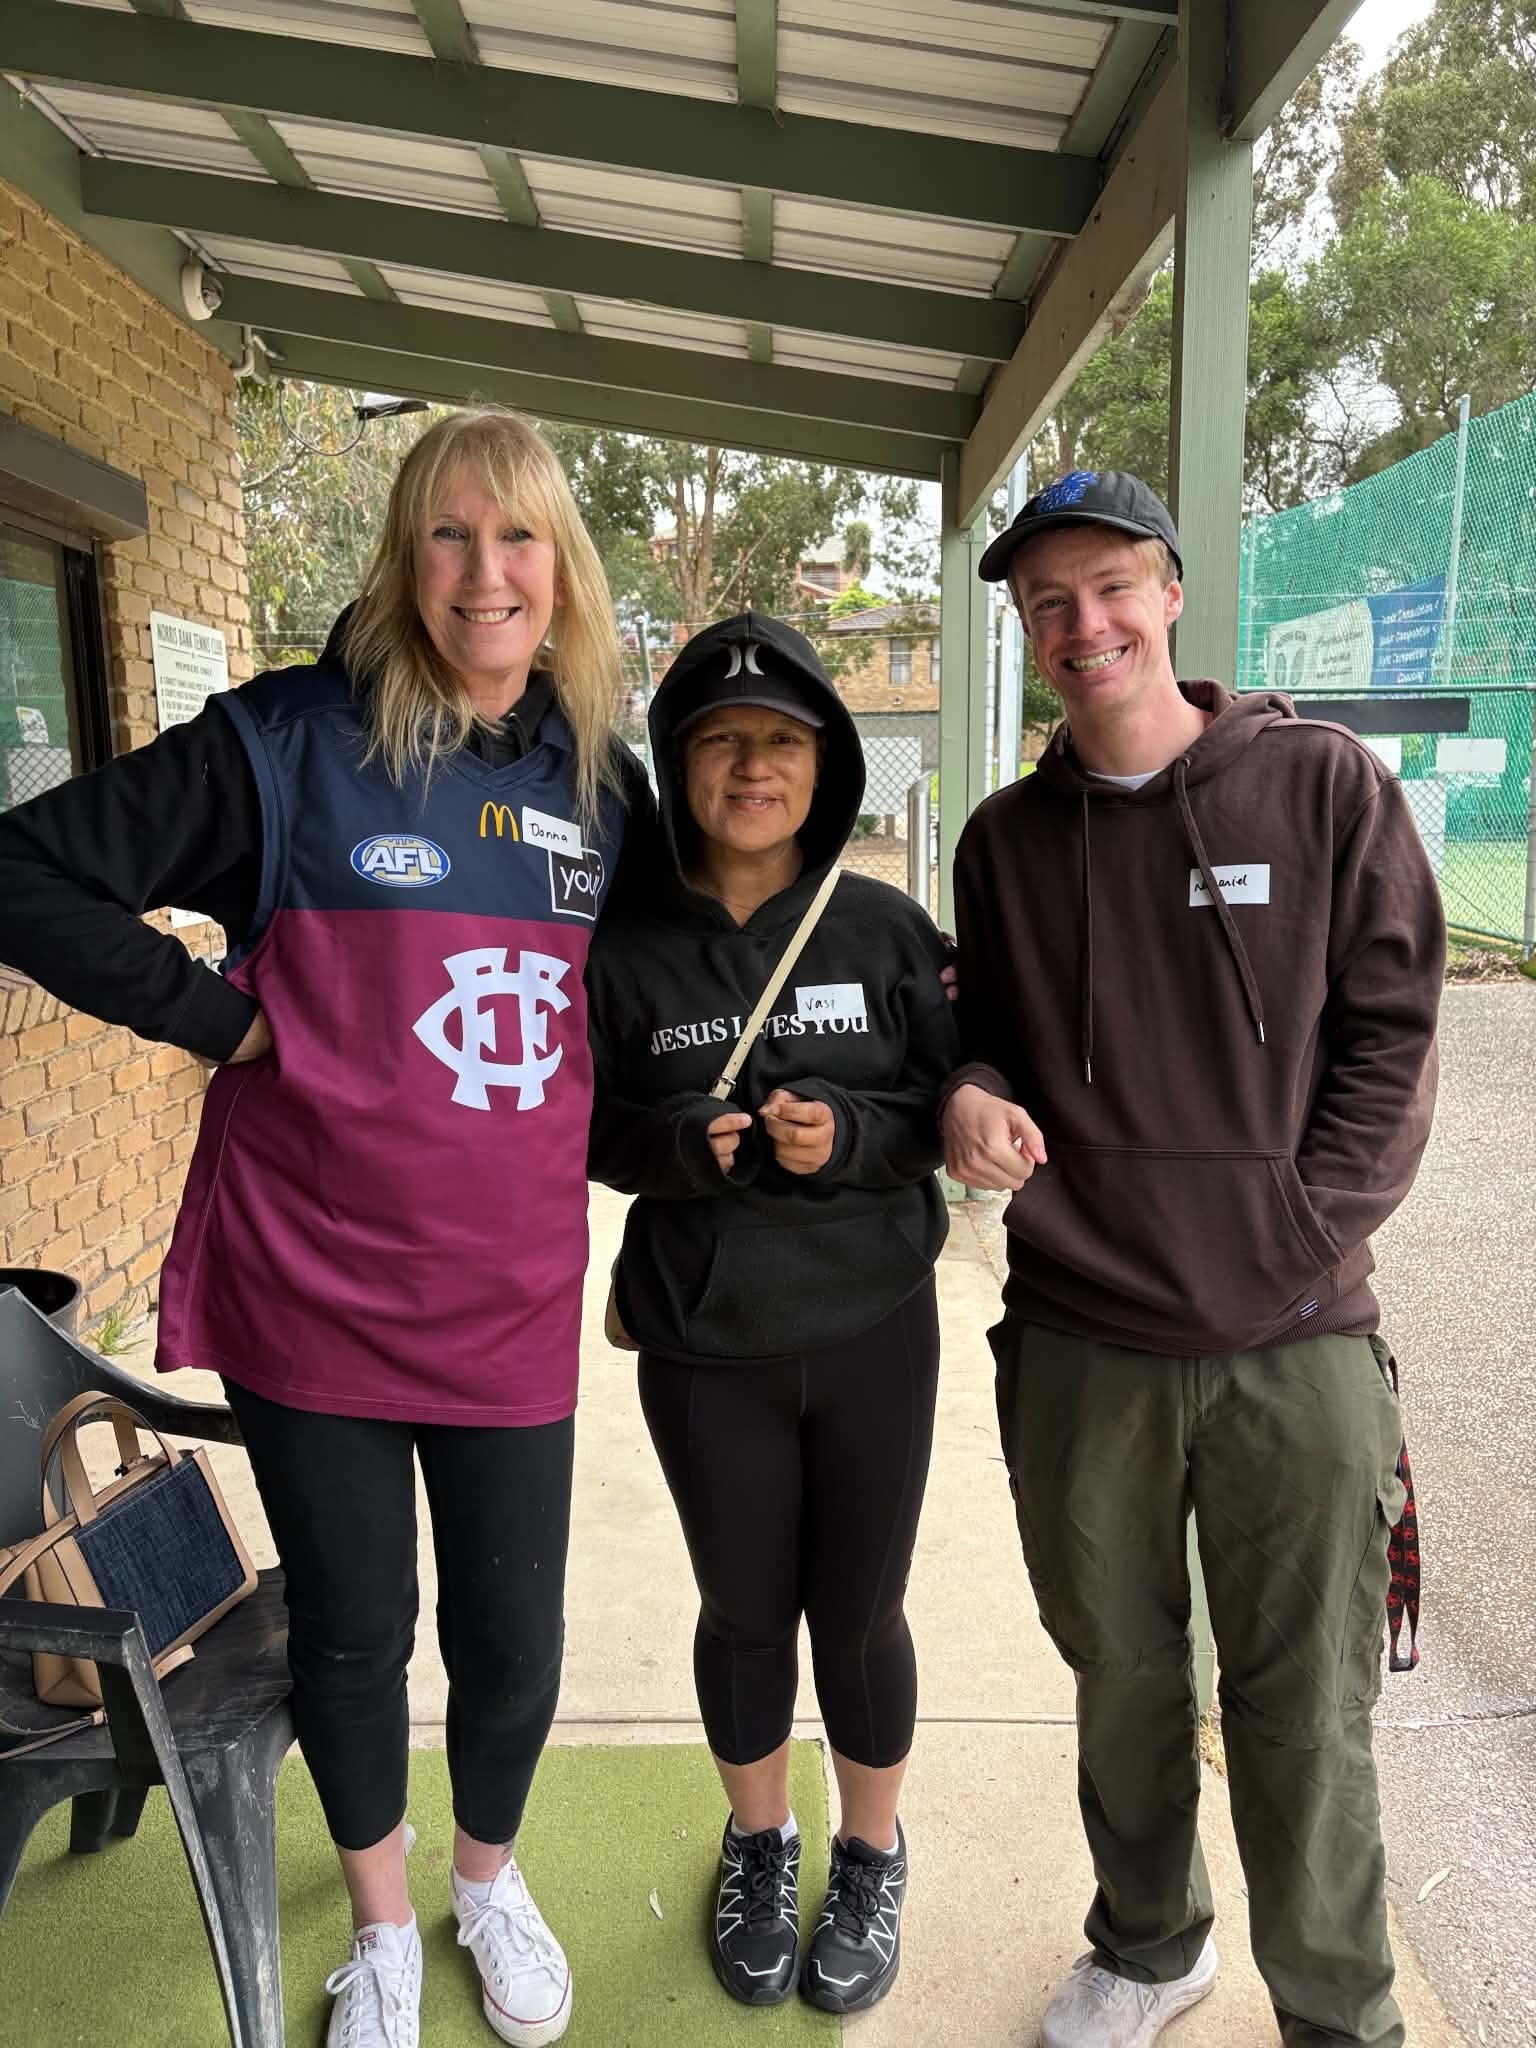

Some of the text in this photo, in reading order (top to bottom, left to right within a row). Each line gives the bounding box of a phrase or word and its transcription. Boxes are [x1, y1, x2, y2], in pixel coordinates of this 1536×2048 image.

[528, 823, 568, 843] Donna
[362, 846, 443, 876] AFL
[650, 1016, 728, 1056] JESUS
[731, 1013, 807, 1041] LVES
